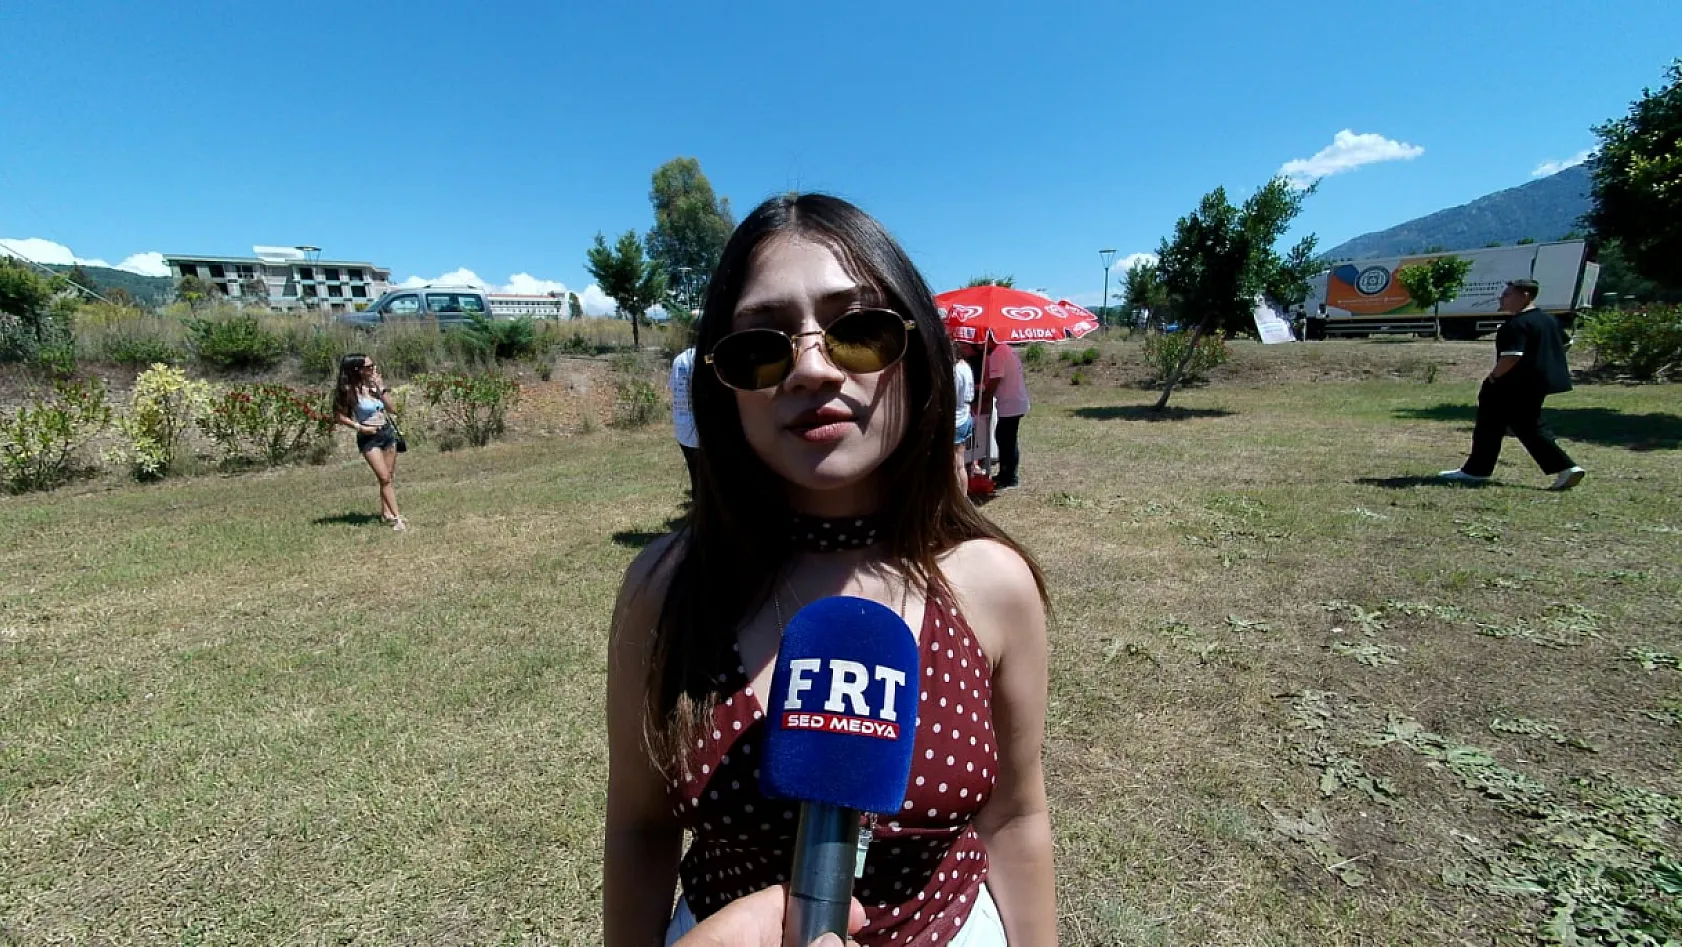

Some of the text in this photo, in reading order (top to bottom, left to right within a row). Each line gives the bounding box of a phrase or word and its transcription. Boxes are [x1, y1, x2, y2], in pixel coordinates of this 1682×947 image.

[1011, 328, 1054, 338] ALGIDA
[784, 659, 906, 721] FRT
[787, 714, 897, 738] SED MEDYA
